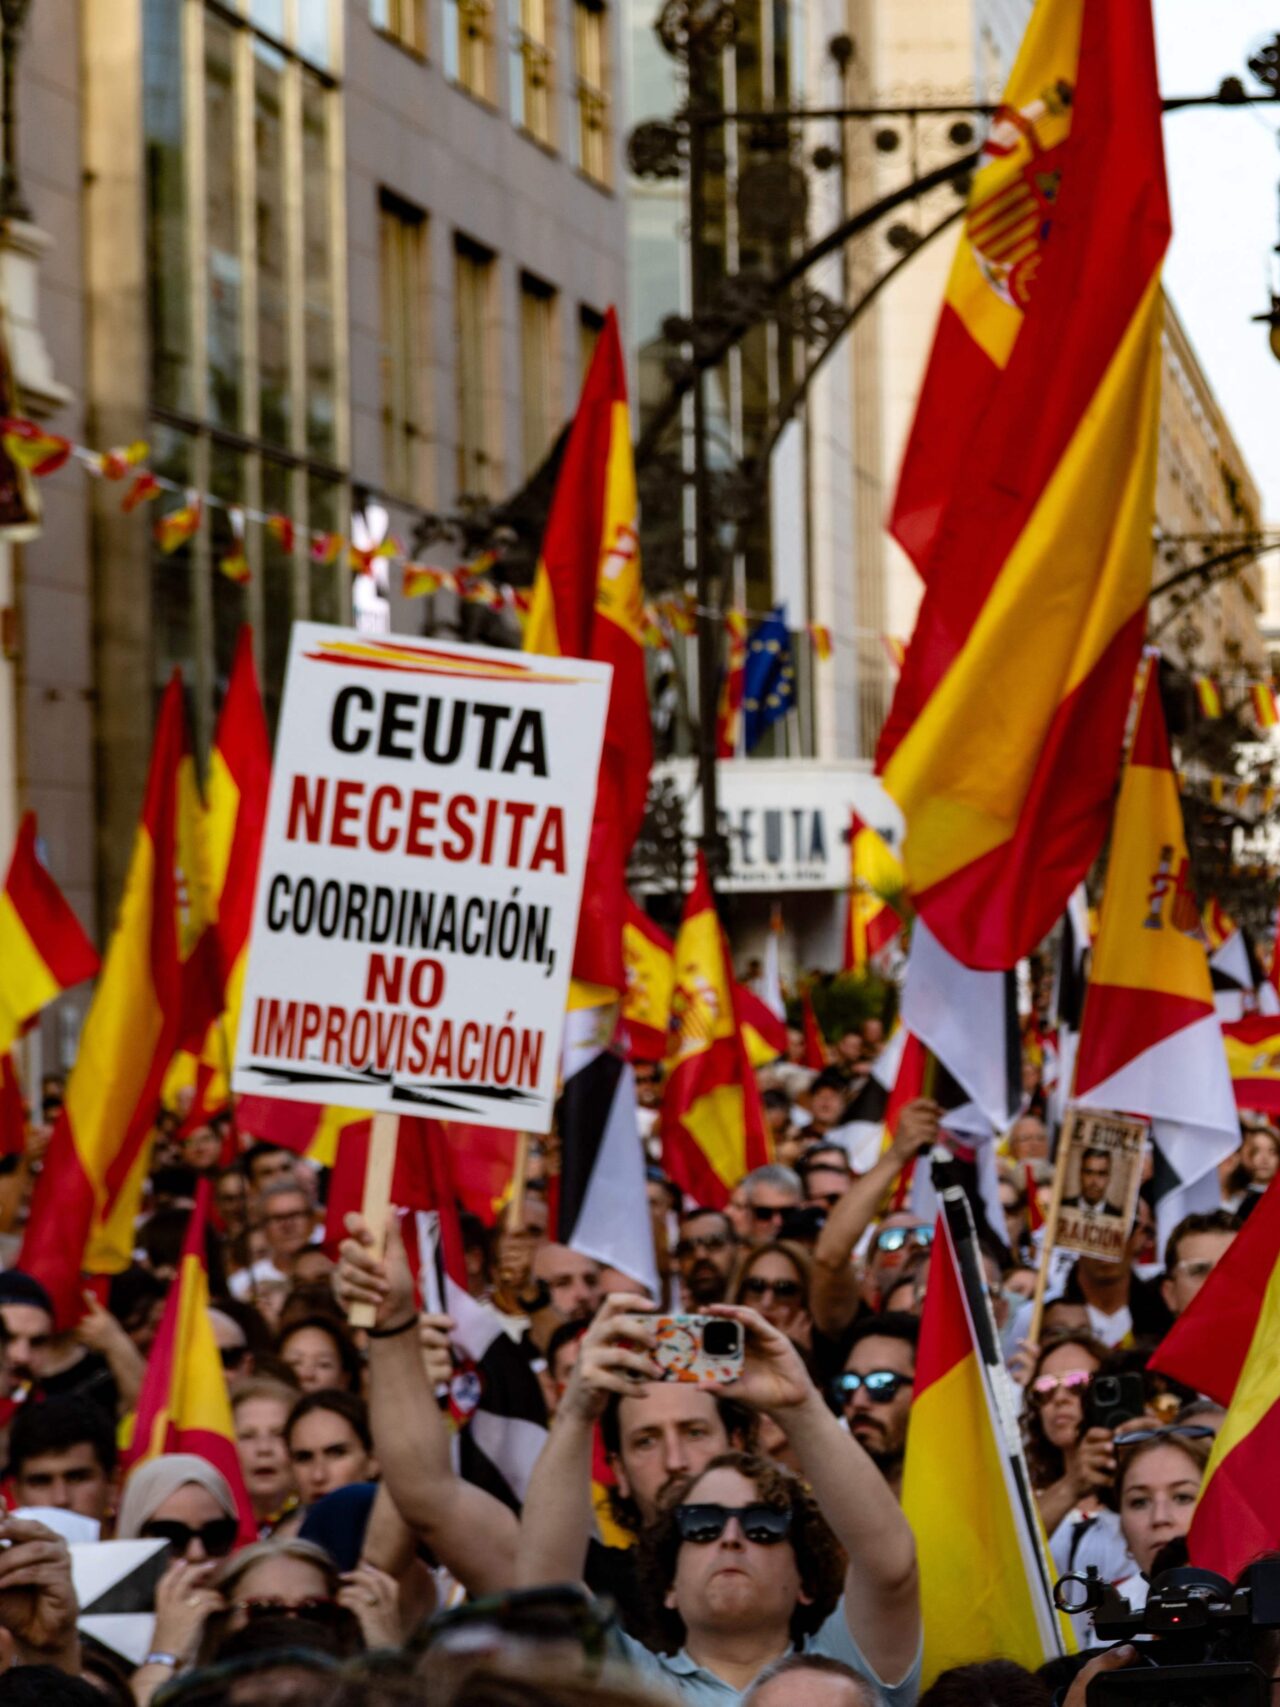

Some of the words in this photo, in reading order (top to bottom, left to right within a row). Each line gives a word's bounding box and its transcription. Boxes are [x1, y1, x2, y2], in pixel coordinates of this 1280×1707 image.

[330, 685, 549, 778] CEUTA
[286, 775, 568, 875] NECESITA
[267, 873, 556, 977] COORDINACIÓN,
[365, 953, 445, 1008] NO
[251, 998, 545, 1089] IMPROVISACIÓN
[1055, 1216, 1124, 1248] RAICIÓN
